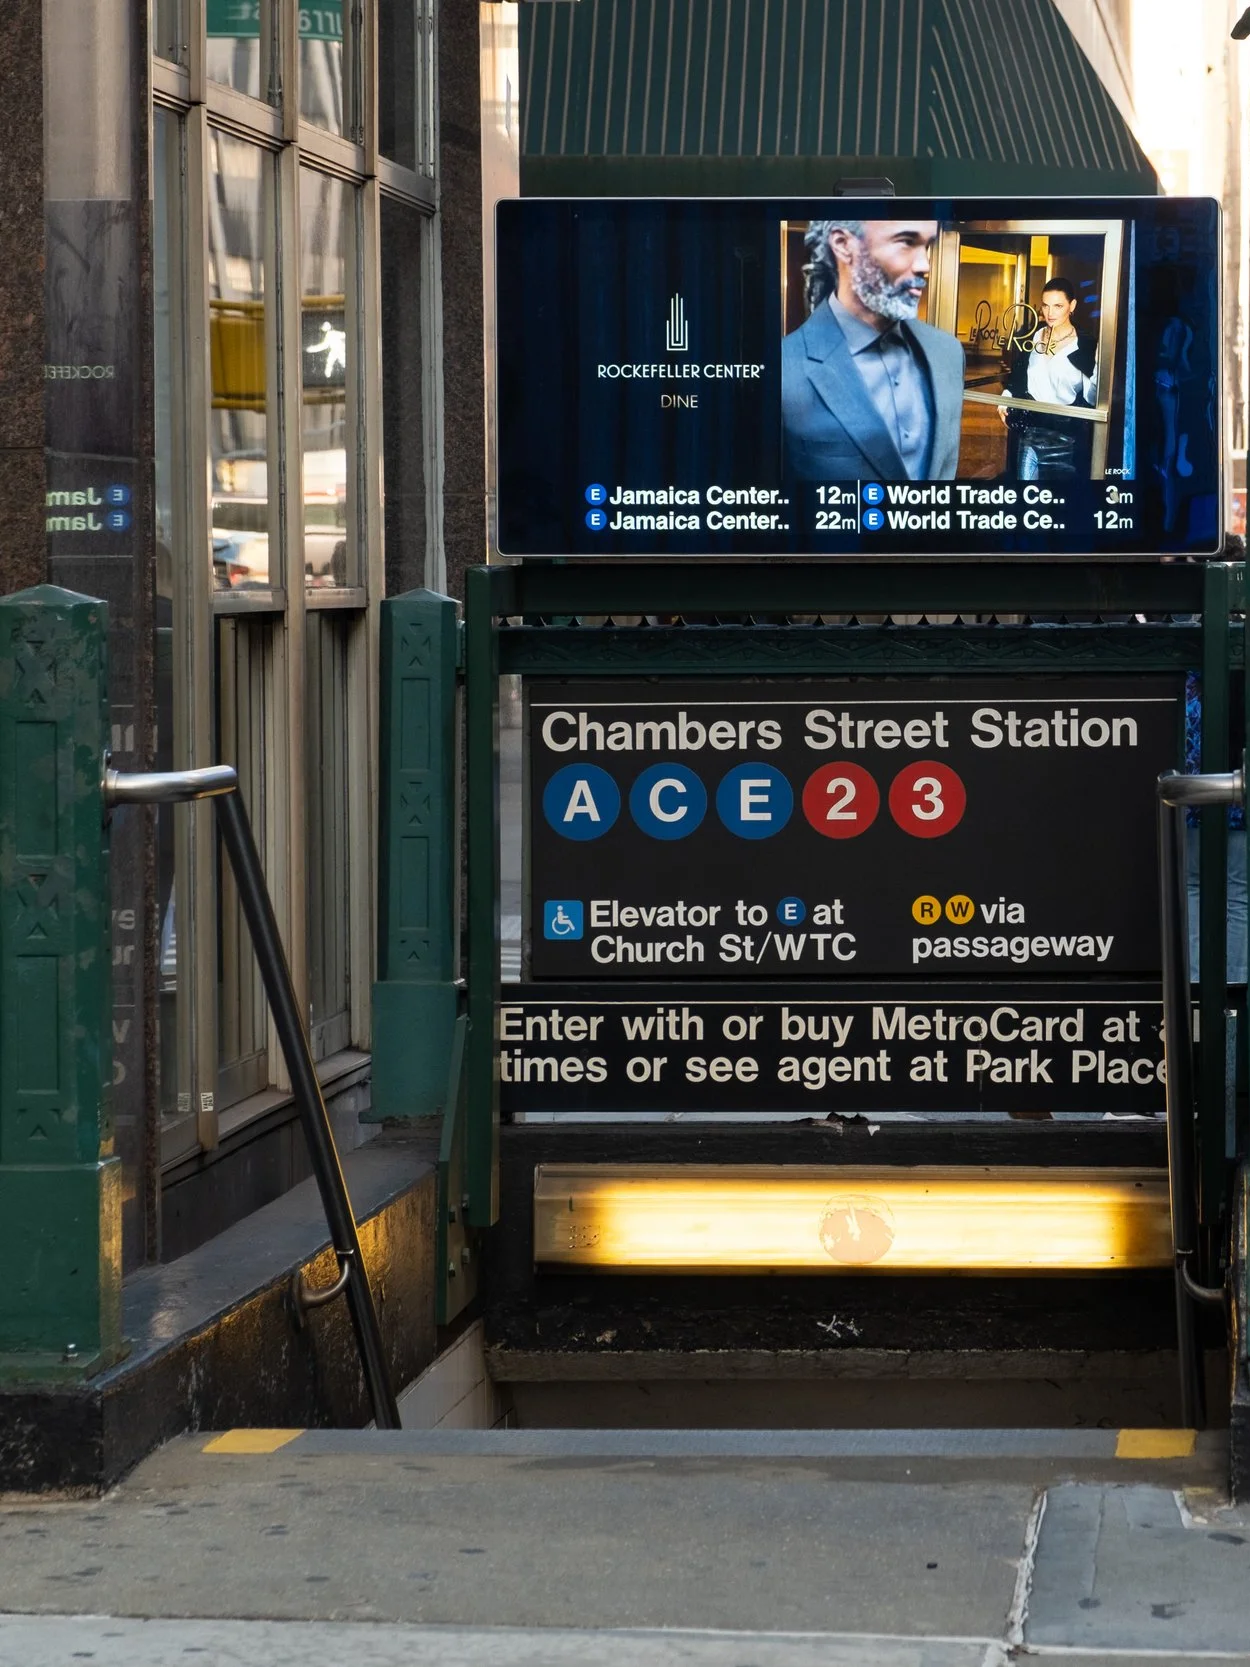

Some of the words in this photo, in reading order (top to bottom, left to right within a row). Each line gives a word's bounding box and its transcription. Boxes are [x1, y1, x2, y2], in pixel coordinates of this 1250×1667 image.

[598, 364, 700, 378] ROCKEFELLER
[661, 395, 698, 408] DINE
[591, 489, 600, 500] E
[609, 486, 700, 505] Jamaica
[706, 486, 789, 505] Center..
[816, 486, 856, 505] 12m
[868, 488, 878, 500] E
[887, 485, 950, 505] World
[956, 485, 1017, 505] Trade
[1023, 485, 1065, 505] Ce..
[1106, 485, 1133, 504] 3m
[591, 514, 600, 525] E
[609, 511, 700, 530] Jamaica
[706, 511, 789, 530] Center..
[815, 511, 856, 530] 22m
[868, 513, 878, 525] E
[887, 510, 950, 530] World
[956, 510, 1017, 530] Trade
[1023, 511, 1065, 530] Ce..
[1093, 510, 1133, 529] 12m
[542, 711, 782, 752] Chambers
[804, 709, 949, 749] Street
[970, 707, 1138, 748] Station
[563, 780, 601, 822] A
[649, 778, 688, 822] C
[740, 779, 772, 821] E
[826, 777, 857, 820] 2
[911, 776, 945, 821] 3
[590, 900, 721, 928] Elevator
[735, 900, 768, 926] to
[784, 903, 797, 920] E
[812, 899, 844, 925] at
[920, 902, 934, 918] R
[950, 902, 970, 918] W
[980, 896, 1025, 924] via
[591, 935, 705, 963] Church
[912, 935, 1114, 964] passageway
[499, 1007, 604, 1041] Enter
[621, 1007, 704, 1041] with
[722, 1014, 764, 1041] or
[781, 1007, 854, 1048] buy
[872, 1006, 1084, 1043] MetroCard
[1102, 1010, 1141, 1043] at
[499, 1048, 608, 1082] times
[626, 1056, 668, 1082] or
[685, 1056, 759, 1082] see
[777, 1049, 891, 1090] agent
[909, 1050, 948, 1082] at
[966, 1049, 1054, 1083] Park
